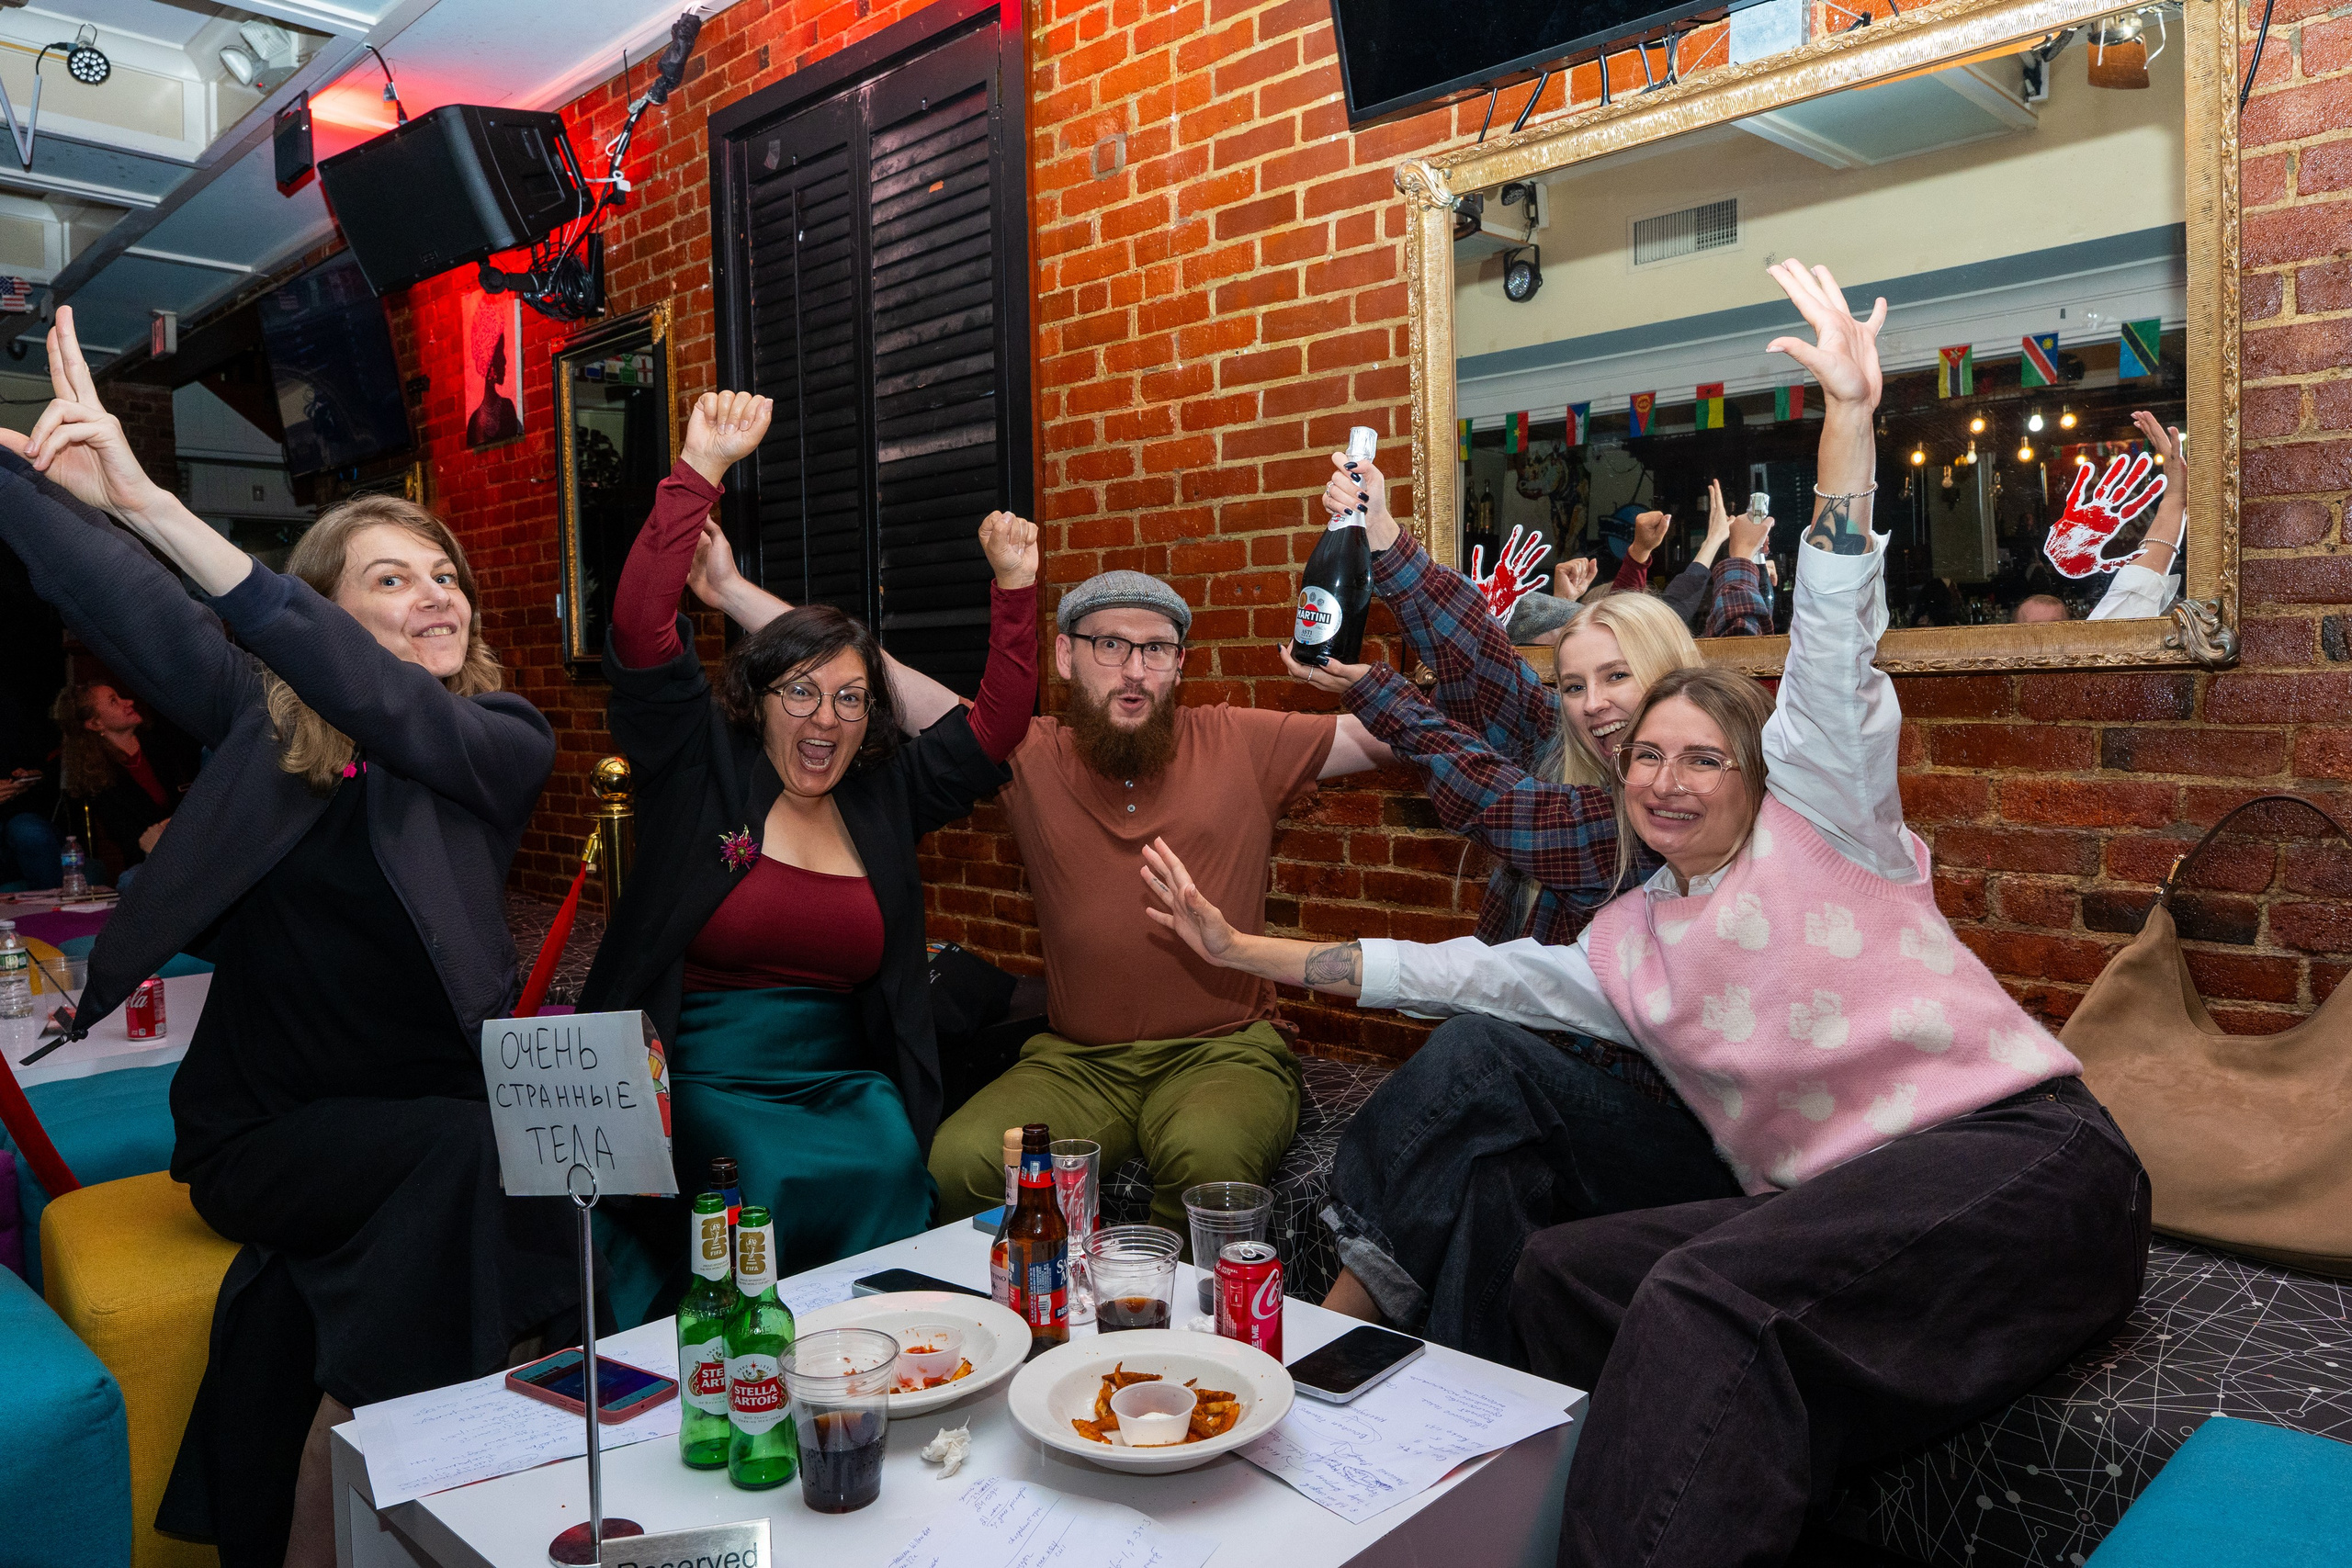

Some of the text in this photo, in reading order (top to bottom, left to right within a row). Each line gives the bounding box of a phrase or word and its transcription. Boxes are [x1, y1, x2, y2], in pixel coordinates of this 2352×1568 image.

[1297, 609, 1330, 624] MARTINI
[501, 1027, 598, 1070] ОЧЕНЬ
[496, 1081, 637, 1109] СТРАННЫЕ
[526, 1124, 616, 1170] ТЕЛА
[1251, 1325, 1259, 1338] ME
[702, 1368, 724, 1378] STE
[701, 1378, 725, 1388] ART
[734, 1384, 778, 1396] STELLA
[734, 1393, 778, 1406] ARTOIS
